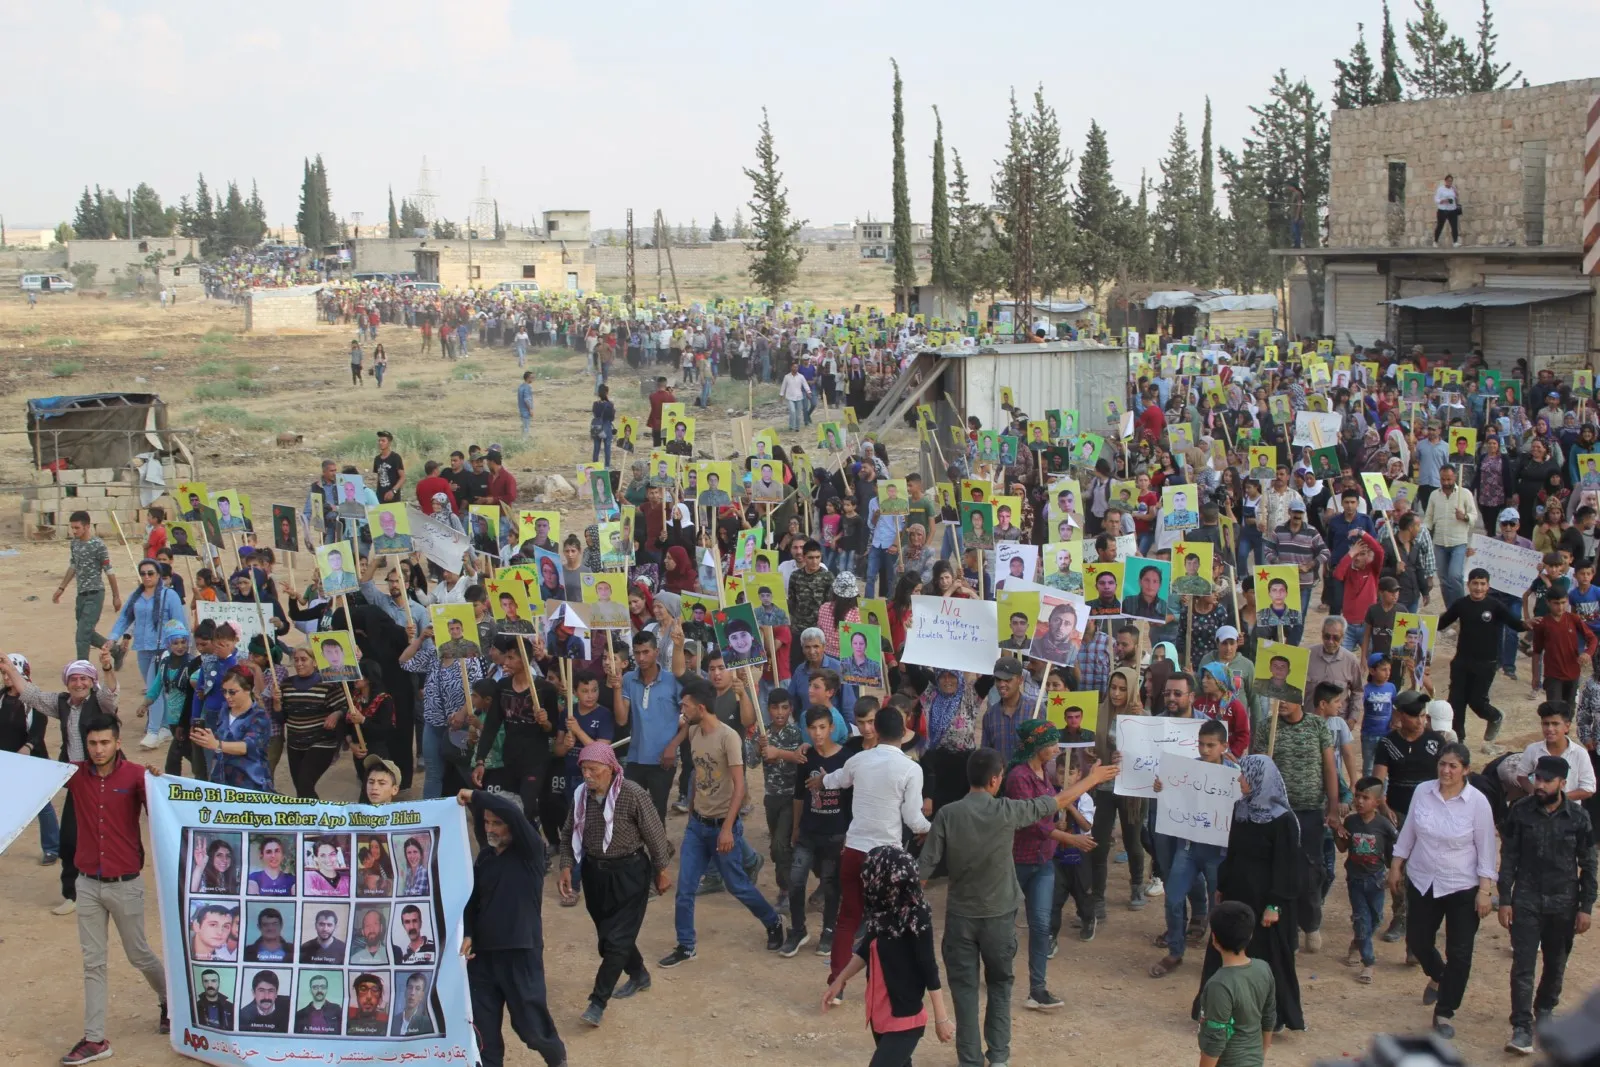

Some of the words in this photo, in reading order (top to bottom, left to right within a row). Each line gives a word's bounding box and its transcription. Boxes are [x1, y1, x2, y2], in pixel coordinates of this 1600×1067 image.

[940, 600, 962, 617] Na
[169, 784, 203, 801] Emê
[205, 788, 222, 802] Bi
[213, 810, 272, 827] Azadiya
[275, 811, 317, 826] Rêber
[183, 1027, 209, 1052] Apo
